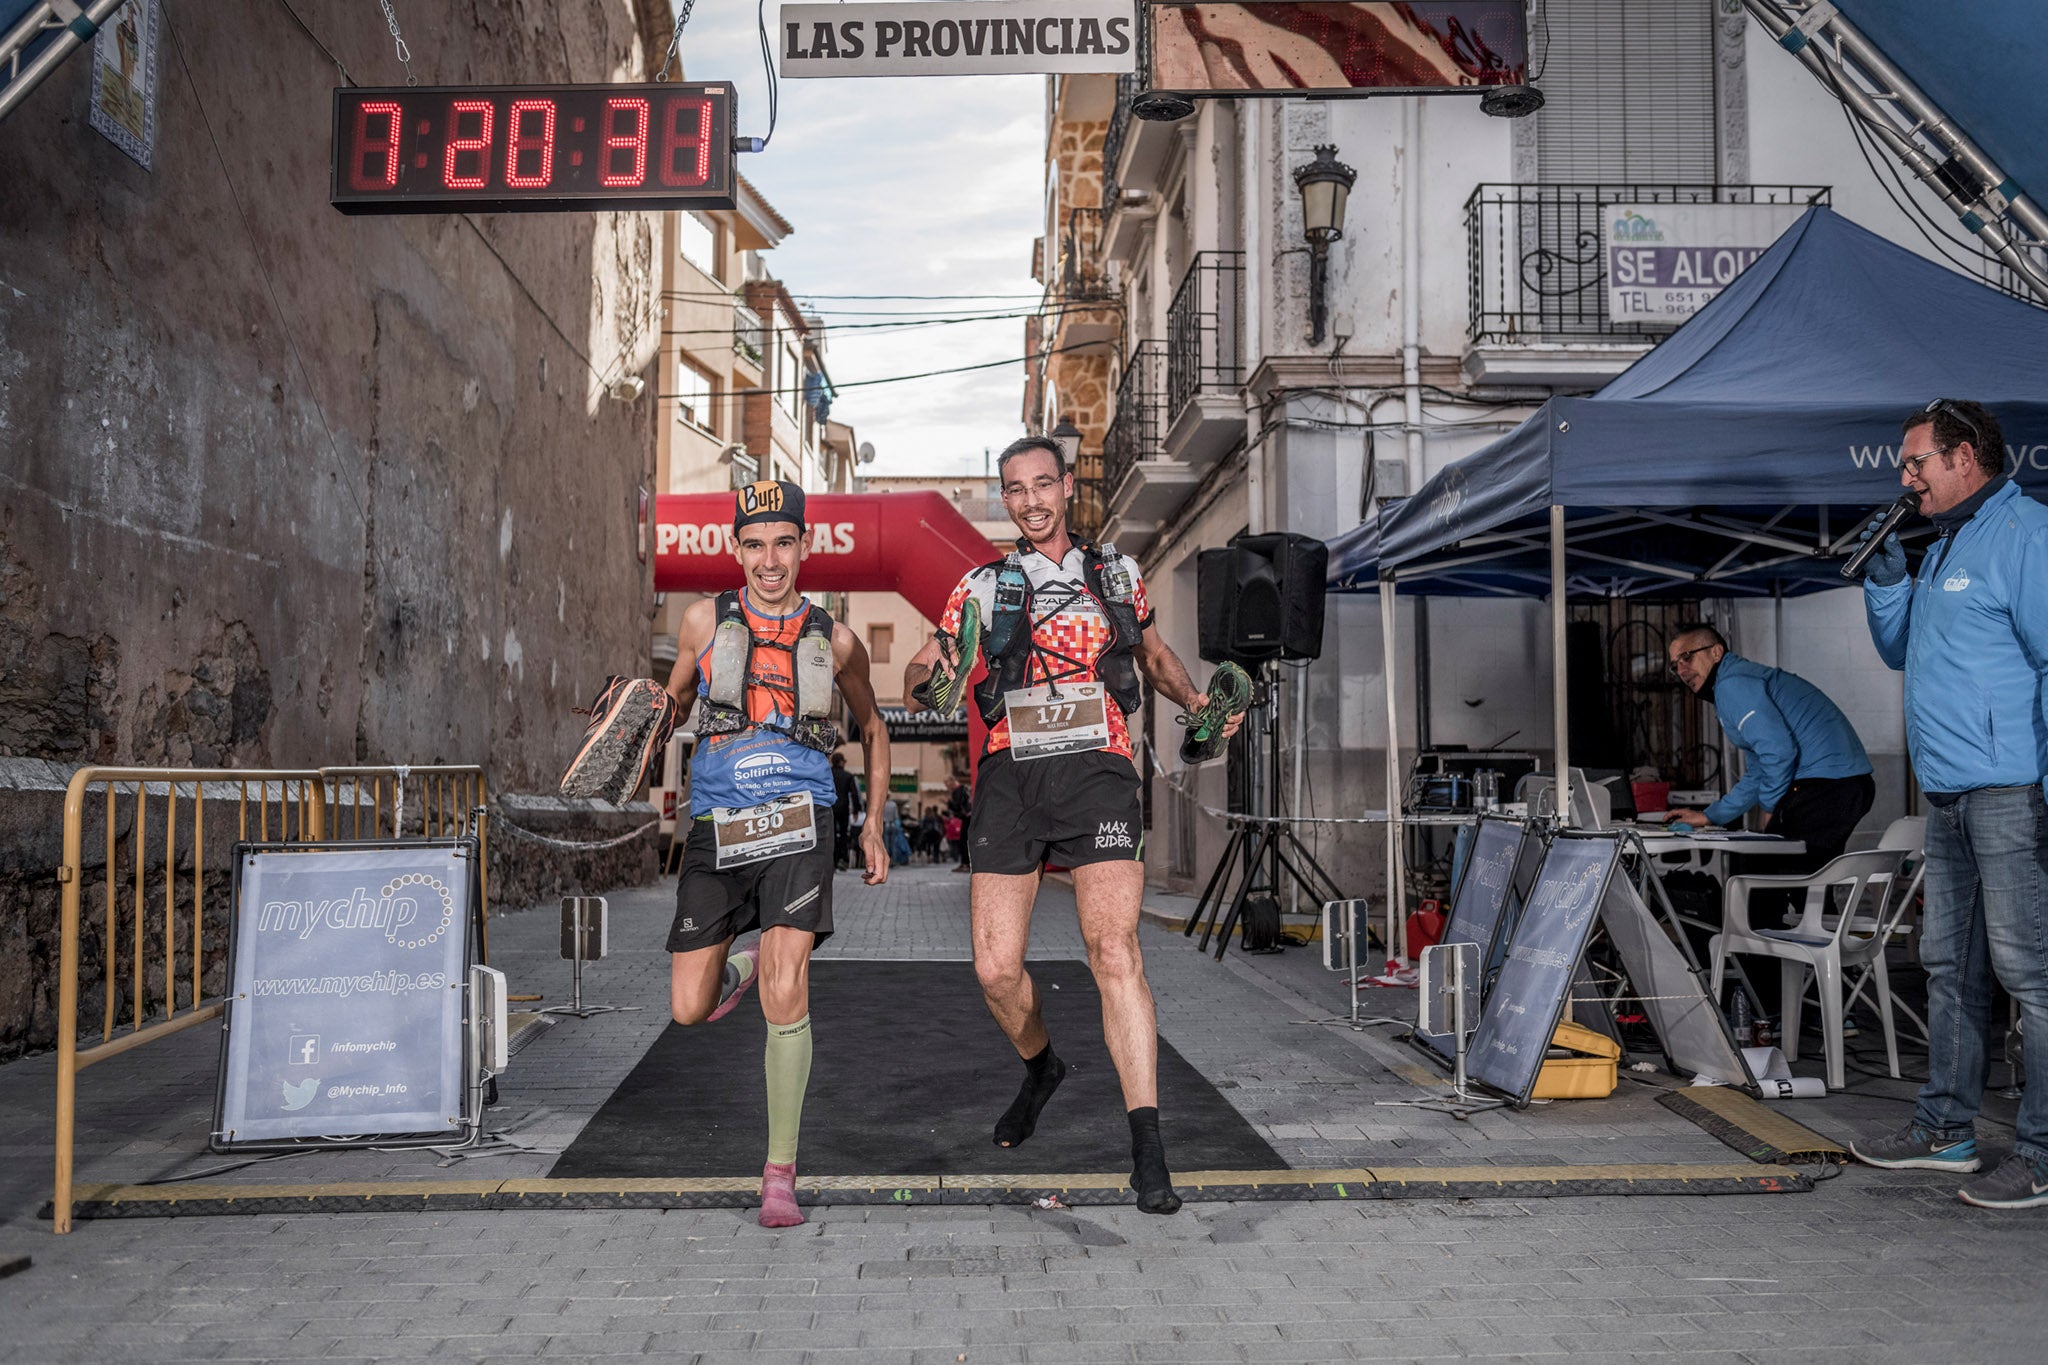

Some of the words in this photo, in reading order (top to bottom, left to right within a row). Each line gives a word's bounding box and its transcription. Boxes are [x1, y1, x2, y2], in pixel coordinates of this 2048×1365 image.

[786, 21, 865, 59] LAS
[874, 17, 1131, 57] PROVINCIAS
[1616, 250, 1656, 284] SE
[1665, 292, 1694, 302] 651
[1665, 304, 1697, 314] 964
[1037, 703, 1077, 724] 177
[734, 765, 792, 781] Soltint.es
[735, 782, 762, 790] Tintado
[744, 812, 784, 836] 190
[1098, 820, 1128, 835] MAX
[1094, 835, 1134, 849] RIDER
[257, 887, 418, 940] mychip
[253, 970, 447, 998] www.mychip.es
[330, 1040, 397, 1053] /infomychip
[327, 1083, 407, 1099] @Mychip_Info
